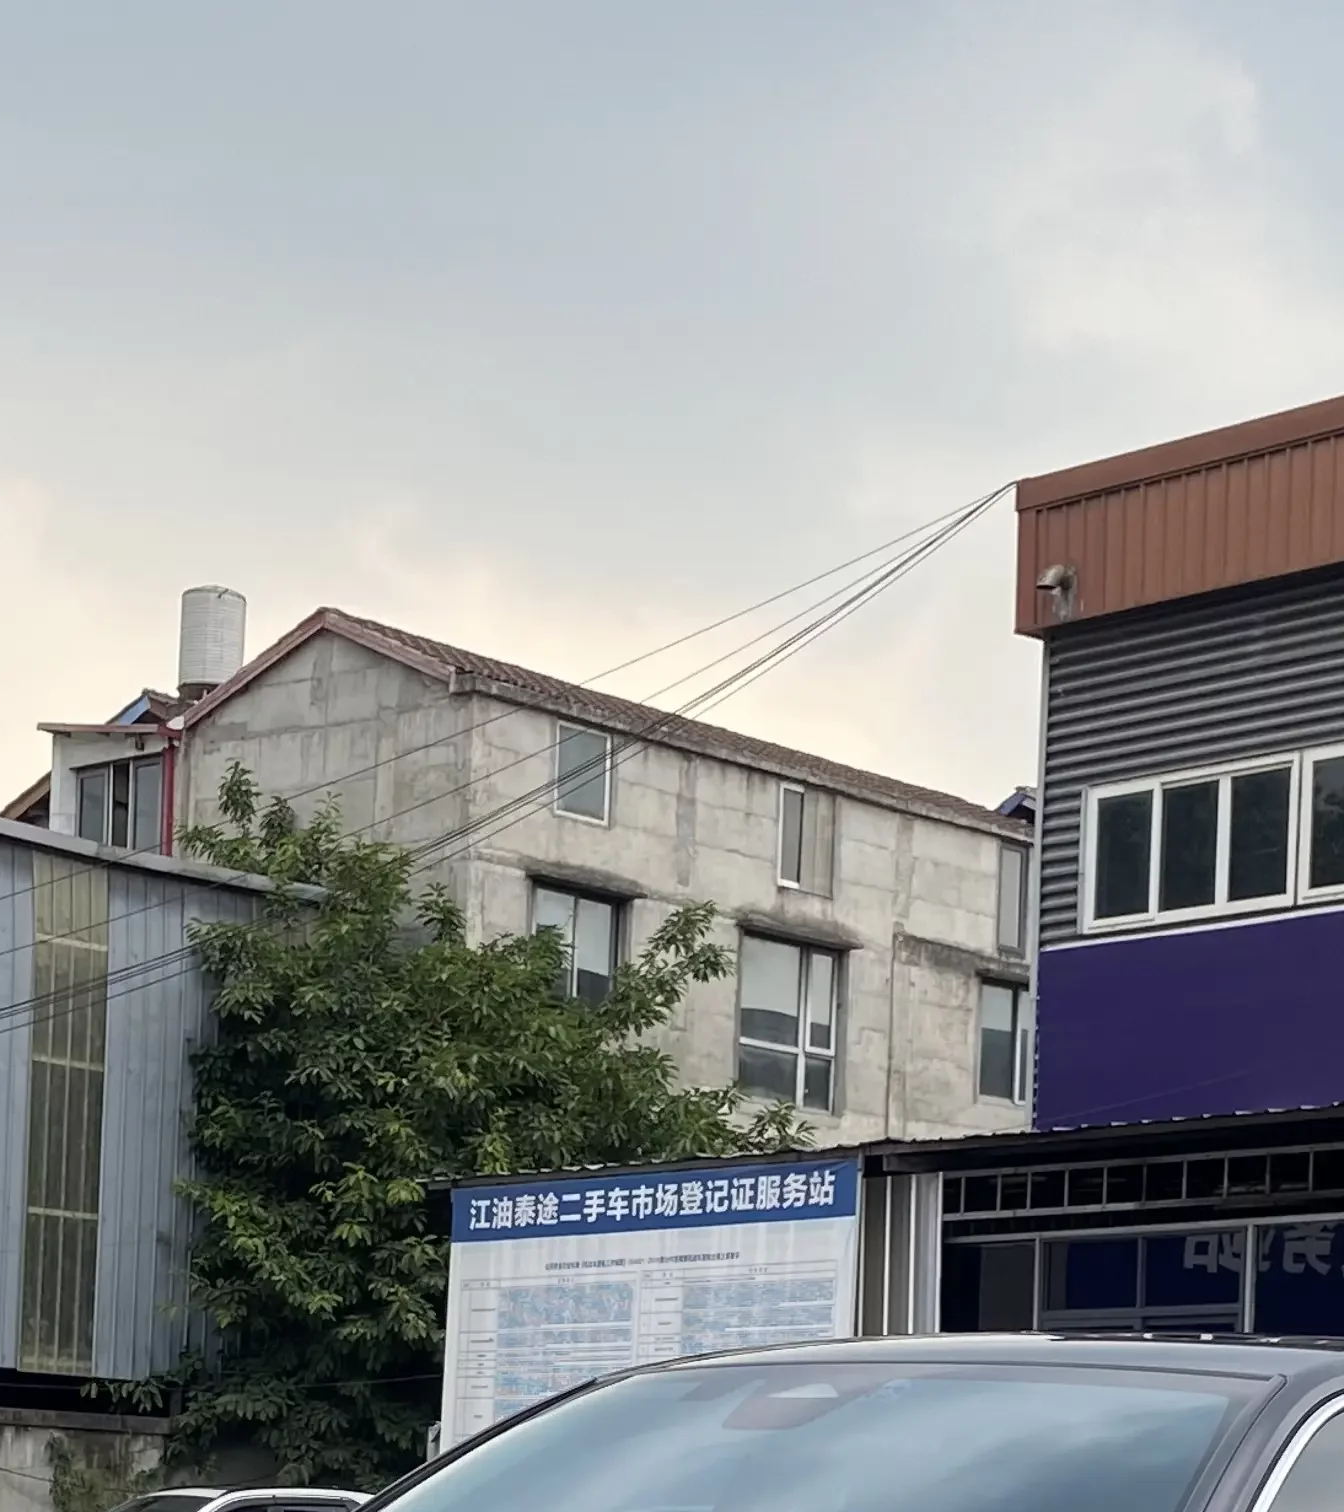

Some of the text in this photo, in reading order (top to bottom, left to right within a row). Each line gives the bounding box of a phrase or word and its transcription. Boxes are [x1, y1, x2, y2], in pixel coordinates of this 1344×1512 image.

[469, 1170, 836, 1232] 江油泰途二手车市场登记证服务站
